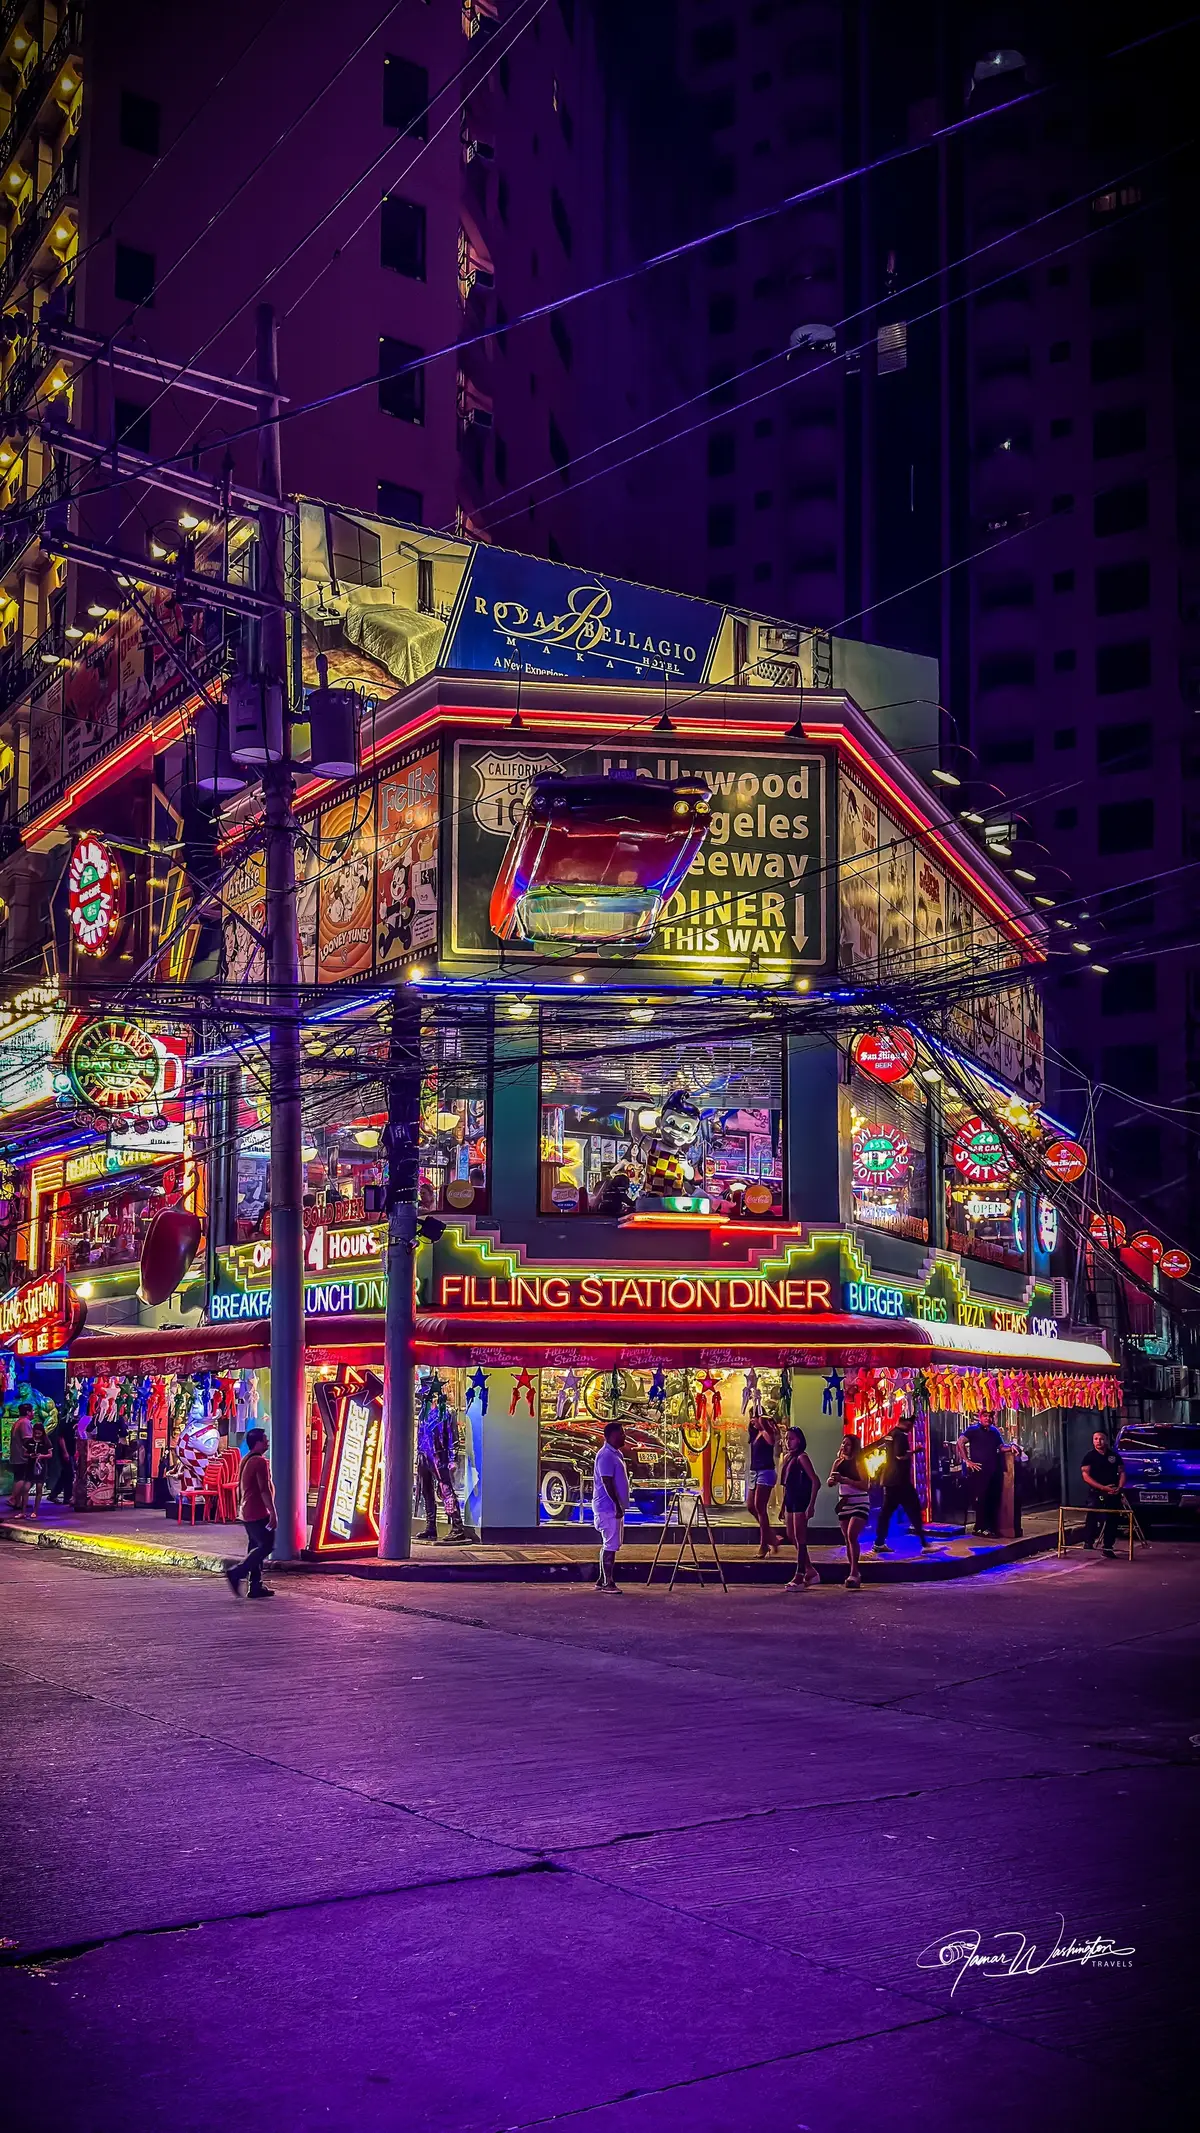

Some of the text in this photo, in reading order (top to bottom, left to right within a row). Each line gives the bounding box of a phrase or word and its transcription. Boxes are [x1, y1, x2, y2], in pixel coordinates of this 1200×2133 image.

[475, 596, 697, 662] ROYAL BELLAGIO
[494, 657, 502, 667] A
[642, 656, 680, 672] HOTEL
[508, 783, 526, 796] US
[603, 758, 809, 799] llwood
[382, 766, 437, 831] Felix
[709, 804, 809, 845] geles
[227, 866, 260, 901] Archie
[688, 850, 809, 888] eeway
[663, 889, 787, 928] DINER
[320, 928, 370, 962] LOONEY TUNES
[661, 927, 787, 953] THIS WAY
[303, 1198, 365, 1228] COLD BEER
[972, 1202, 1002, 1213] OPEN
[253, 1244, 272, 1268] OP
[212, 1292, 272, 1319] BREAKFA
[304, 1283, 352, 1314] UNCH
[441, 1275, 832, 1310] FILLING STATION DINER
[849, 1282, 1058, 1339] BURGER FRIES PIZZA STEAKS CHOPS
[553, 1354, 598, 1365] Station
[708, 1355, 751, 1366] Station
[330, 1399, 370, 1540] FIREHOUSE
